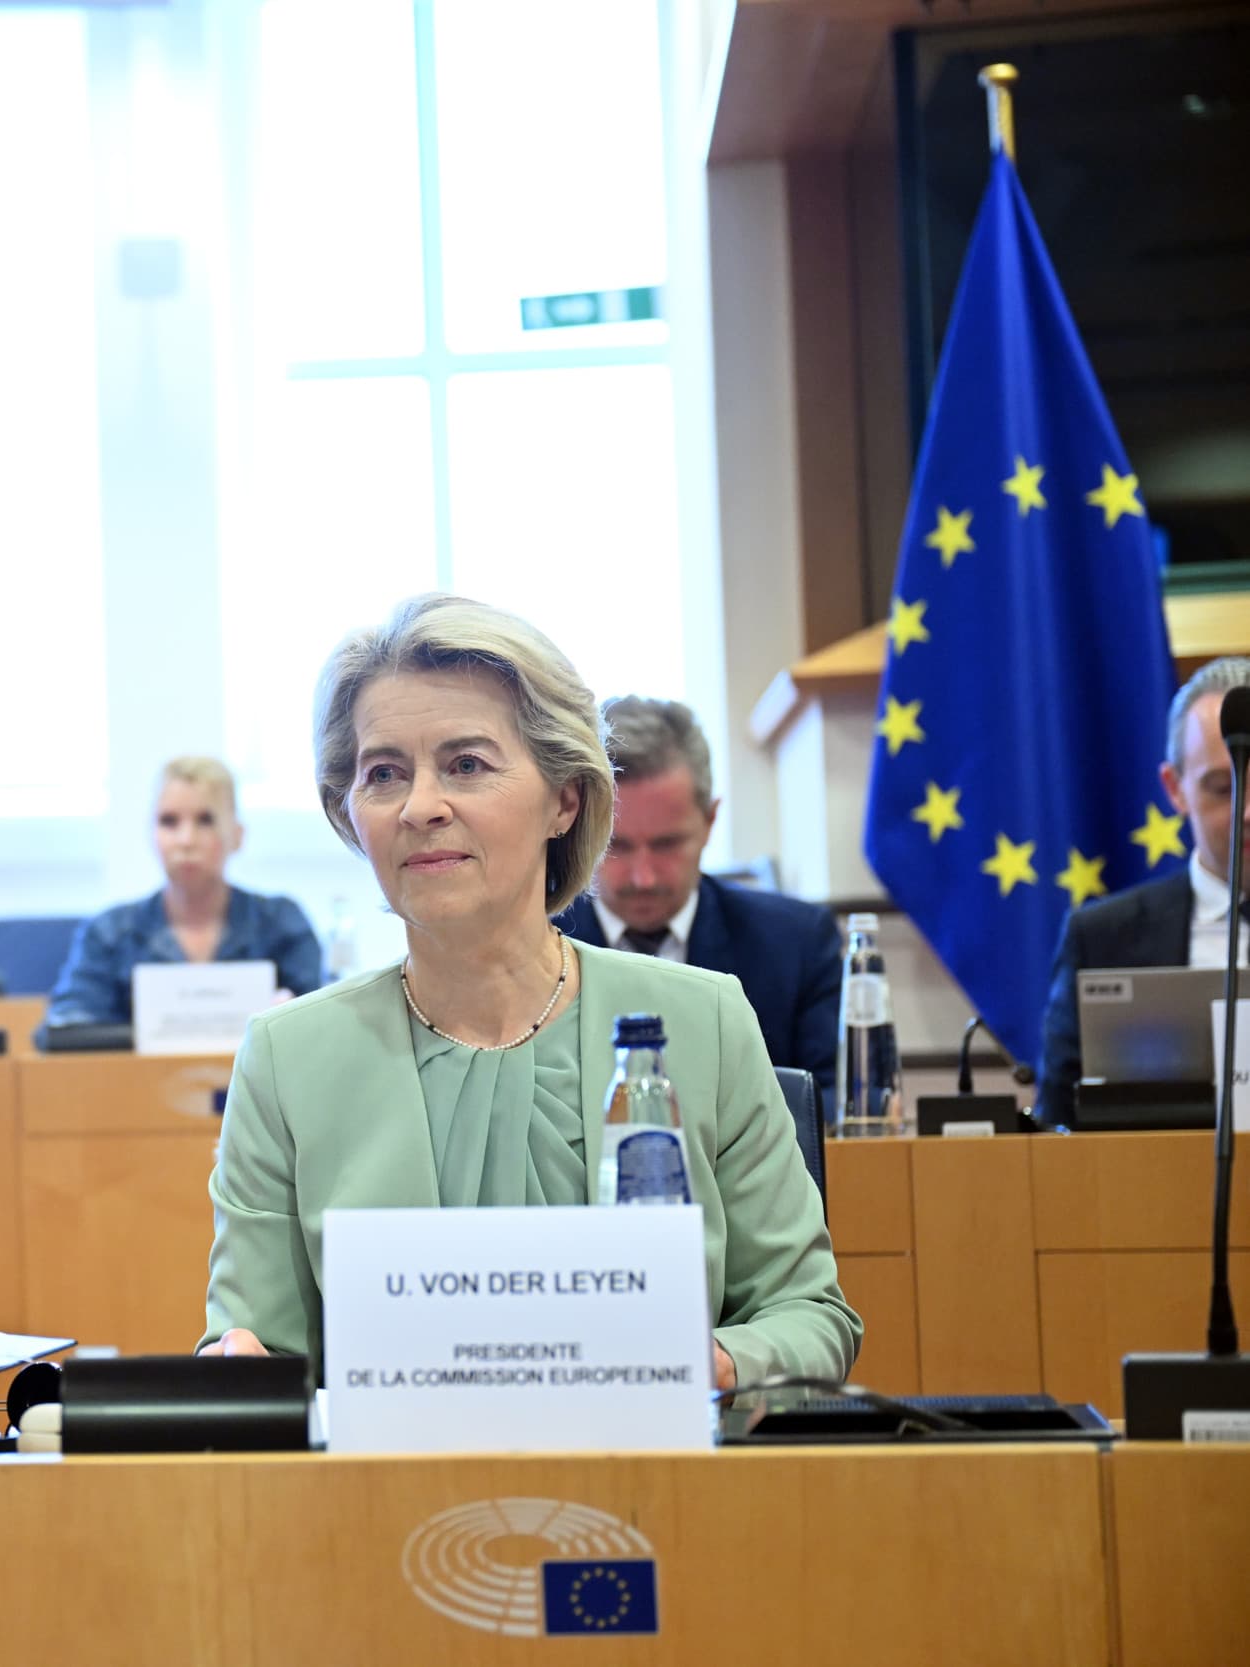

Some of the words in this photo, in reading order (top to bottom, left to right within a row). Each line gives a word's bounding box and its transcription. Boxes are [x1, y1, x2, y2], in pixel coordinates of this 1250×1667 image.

[386, 1274, 412, 1297] U.
[419, 1272, 480, 1297] VON
[487, 1271, 546, 1296] DER
[553, 1269, 647, 1295] LEYEN
[453, 1342, 581, 1362] PRESIDENTE
[346, 1370, 373, 1388] DE
[379, 1369, 406, 1387] LA
[410, 1367, 544, 1387] COMMISSION
[548, 1366, 691, 1386] EUROPEENNE
